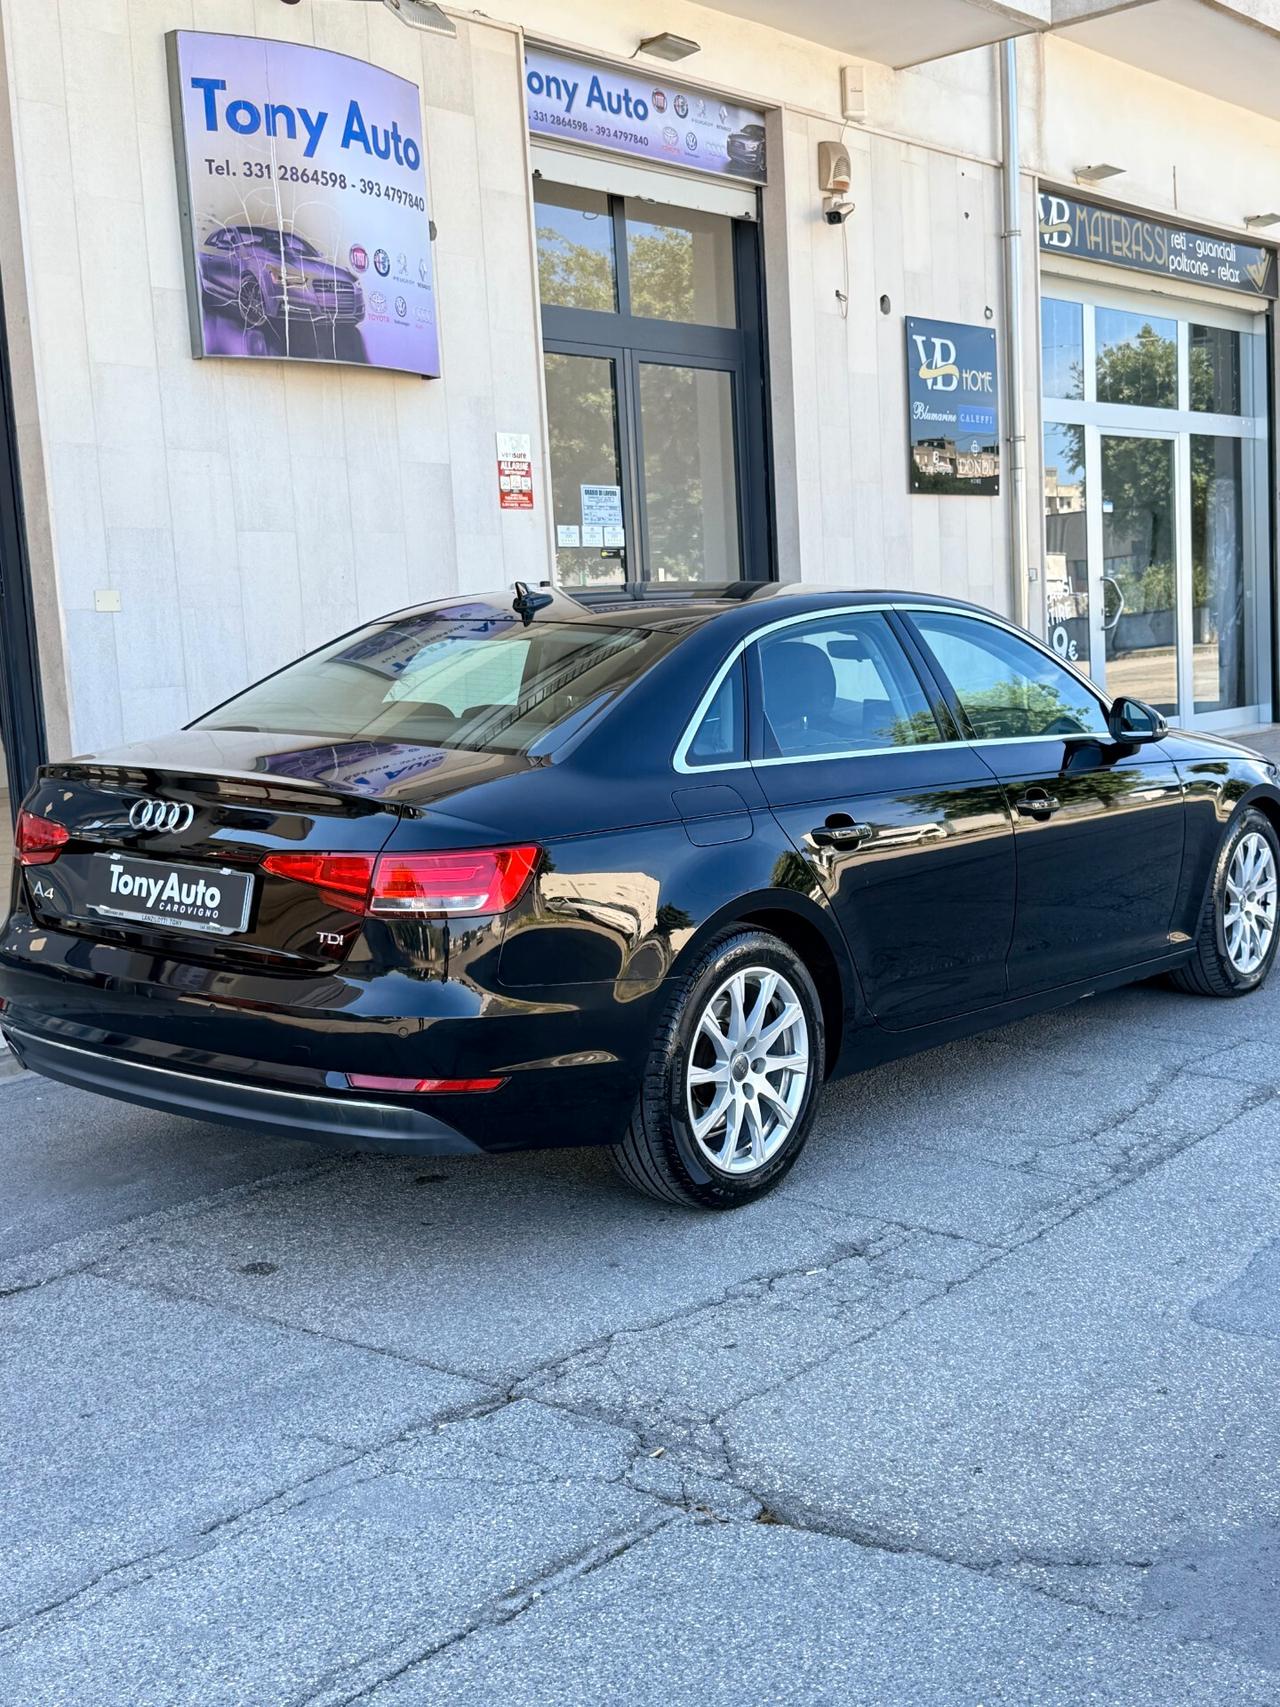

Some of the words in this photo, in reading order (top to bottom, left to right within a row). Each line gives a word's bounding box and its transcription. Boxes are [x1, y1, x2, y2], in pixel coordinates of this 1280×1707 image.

[586, 74, 649, 121] Auto
[190, 77, 329, 158] Tony
[340, 99, 421, 171] Auto
[533, 110, 548, 126] 331
[550, 114, 588, 132] 2864598
[596, 125, 612, 138] 393
[612, 132, 649, 147] 4797840
[204, 158, 237, 177] Tel.
[242, 161, 272, 180] 331
[278, 164, 347, 190] 2864598
[359, 178, 382, 198] 393
[383, 185, 425, 212] 4797840
[1075, 205, 1169, 267] MATERASSI
[1170, 232, 1187, 251] reti
[1195, 240, 1237, 262] guanciali
[1168, 252, 1209, 277] poltrone
[1217, 262, 1241, 283] relax
[962, 369, 993, 392] HOME
[913, 401, 957, 422] Blumarine
[960, 413, 993, 425] CALEFFI
[33, 880, 54, 900] A4
[159, 902, 219, 919] CAROVIGNO
[316, 931, 344, 946] TDI
